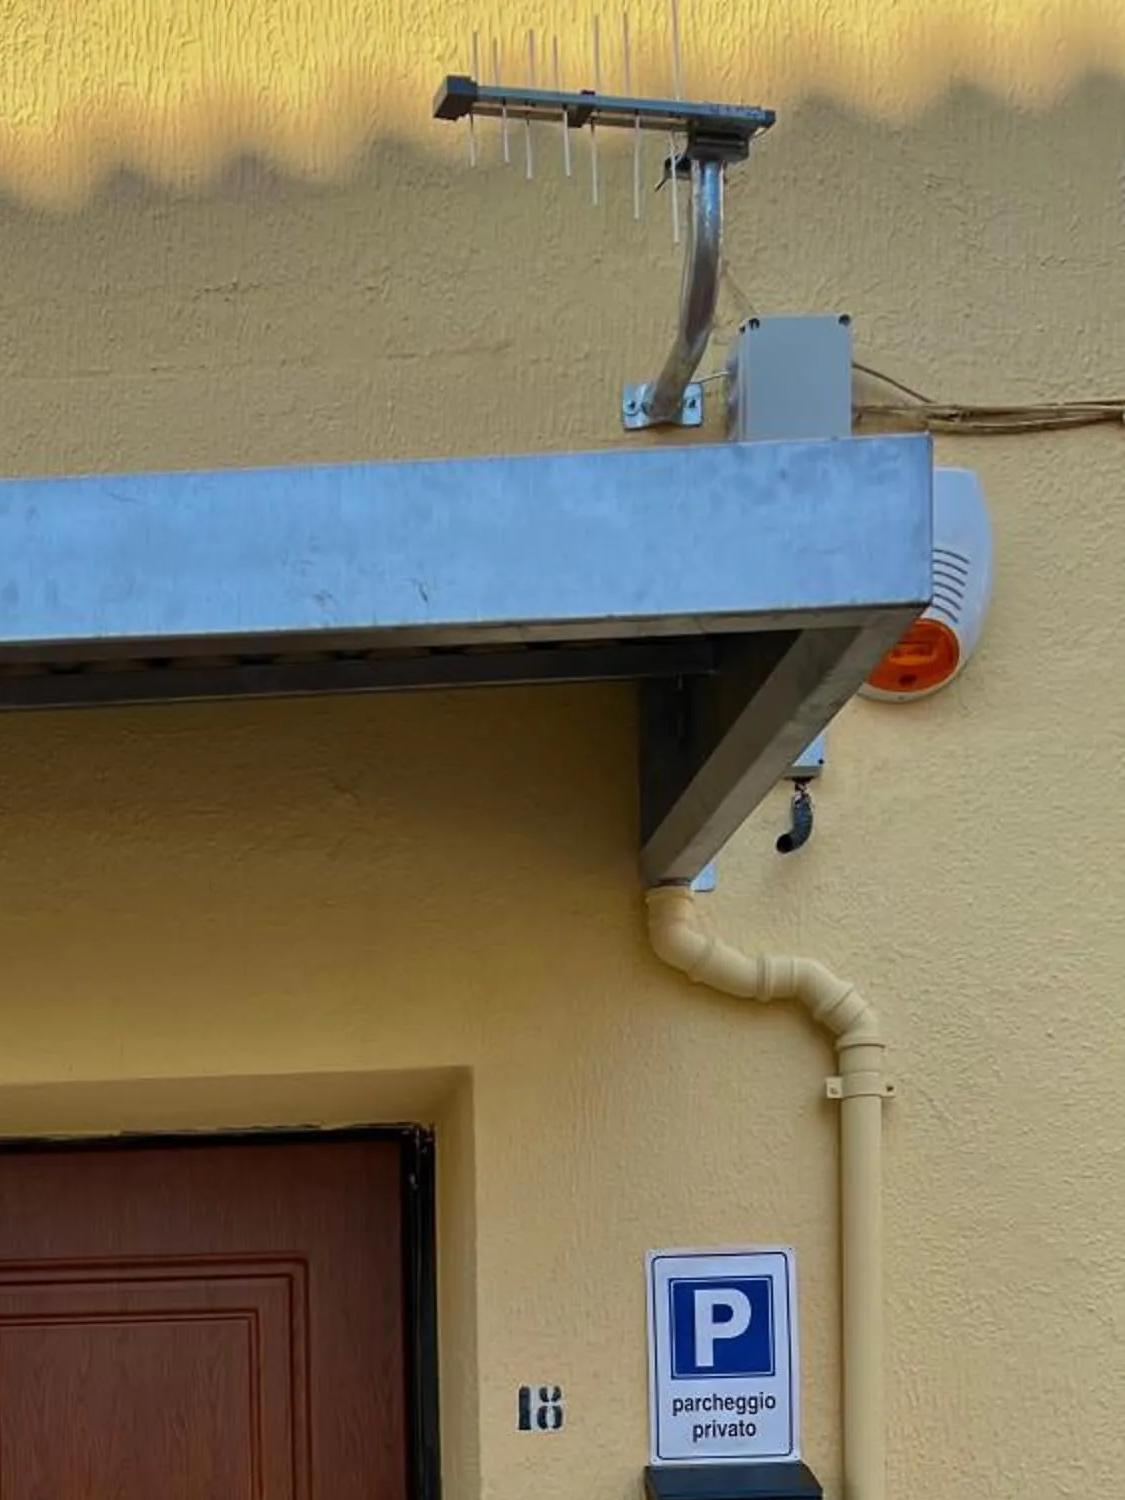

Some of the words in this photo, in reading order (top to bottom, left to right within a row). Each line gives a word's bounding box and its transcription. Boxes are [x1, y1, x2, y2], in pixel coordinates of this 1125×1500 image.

[693, 1288, 752, 1367] P
[518, 1386, 563, 1430] 18
[672, 1391, 776, 1416] parcheggio
[692, 1420, 756, 1442] privato
